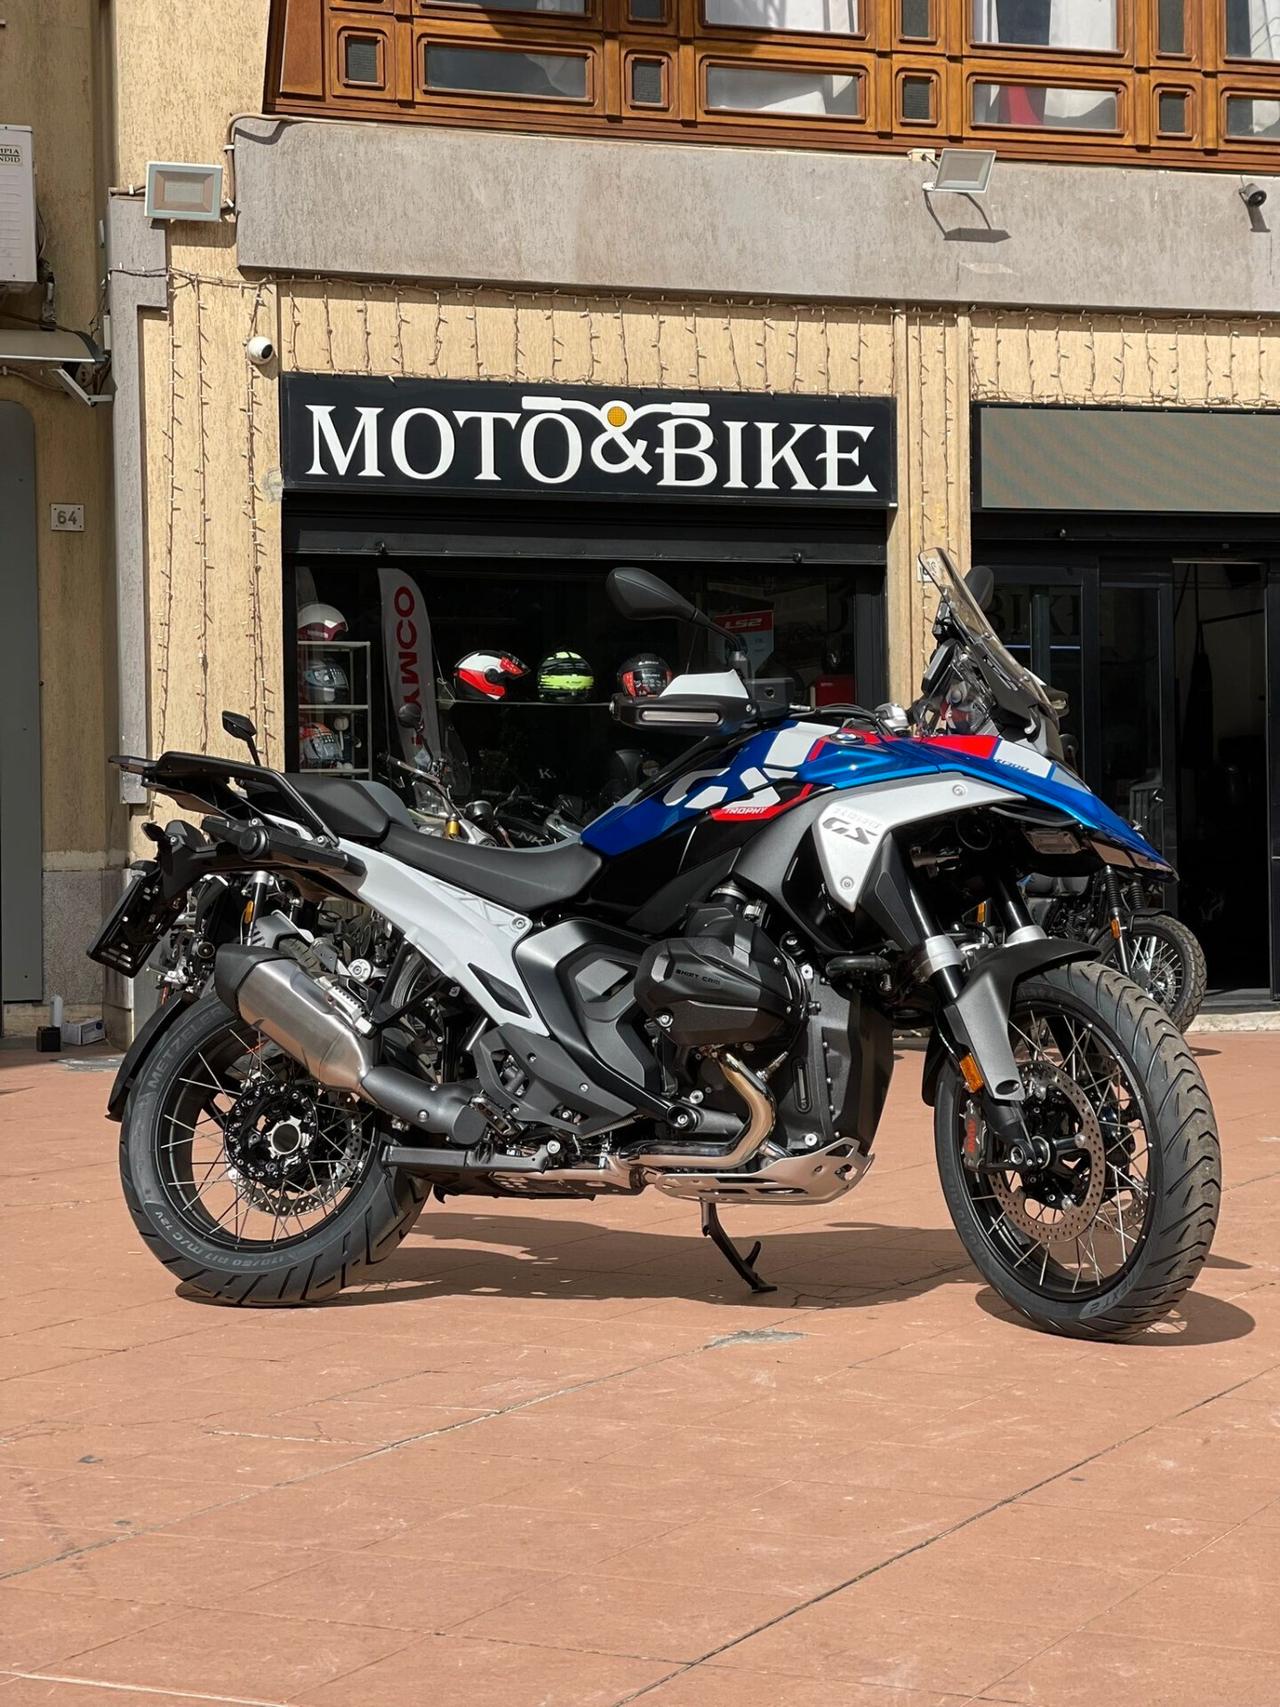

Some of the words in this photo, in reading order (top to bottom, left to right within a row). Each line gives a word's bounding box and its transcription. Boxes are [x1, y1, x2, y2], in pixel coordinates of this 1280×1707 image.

[305, 397, 878, 493] MOTO&BIKE
[57, 510, 78, 525] 64
[723, 806, 769, 816] TROPHY
